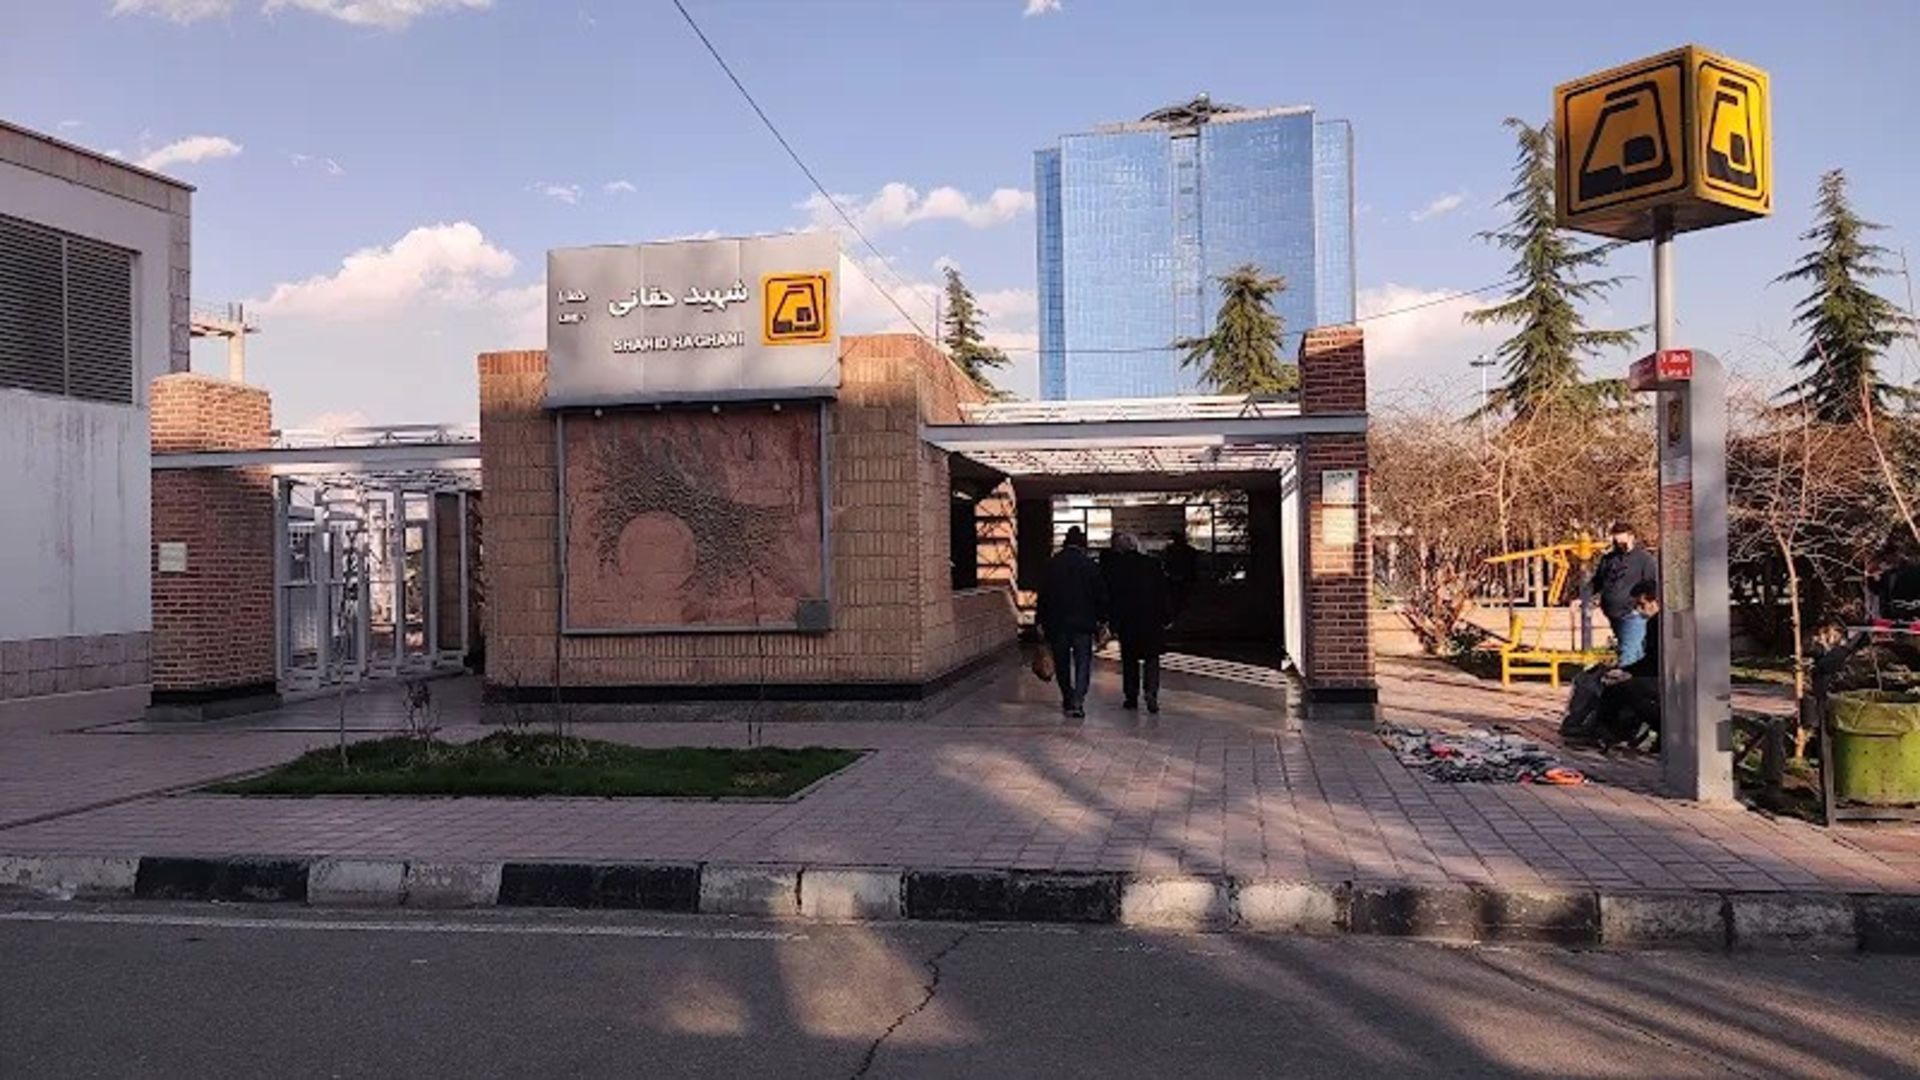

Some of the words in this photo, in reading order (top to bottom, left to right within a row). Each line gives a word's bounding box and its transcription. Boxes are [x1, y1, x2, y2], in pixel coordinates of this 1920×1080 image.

[608, 285, 676, 316] حقانی
[683, 278, 749, 312] شهید
[613, 336, 669, 353] SHAHID
[673, 331, 744, 350] HAGHANI
